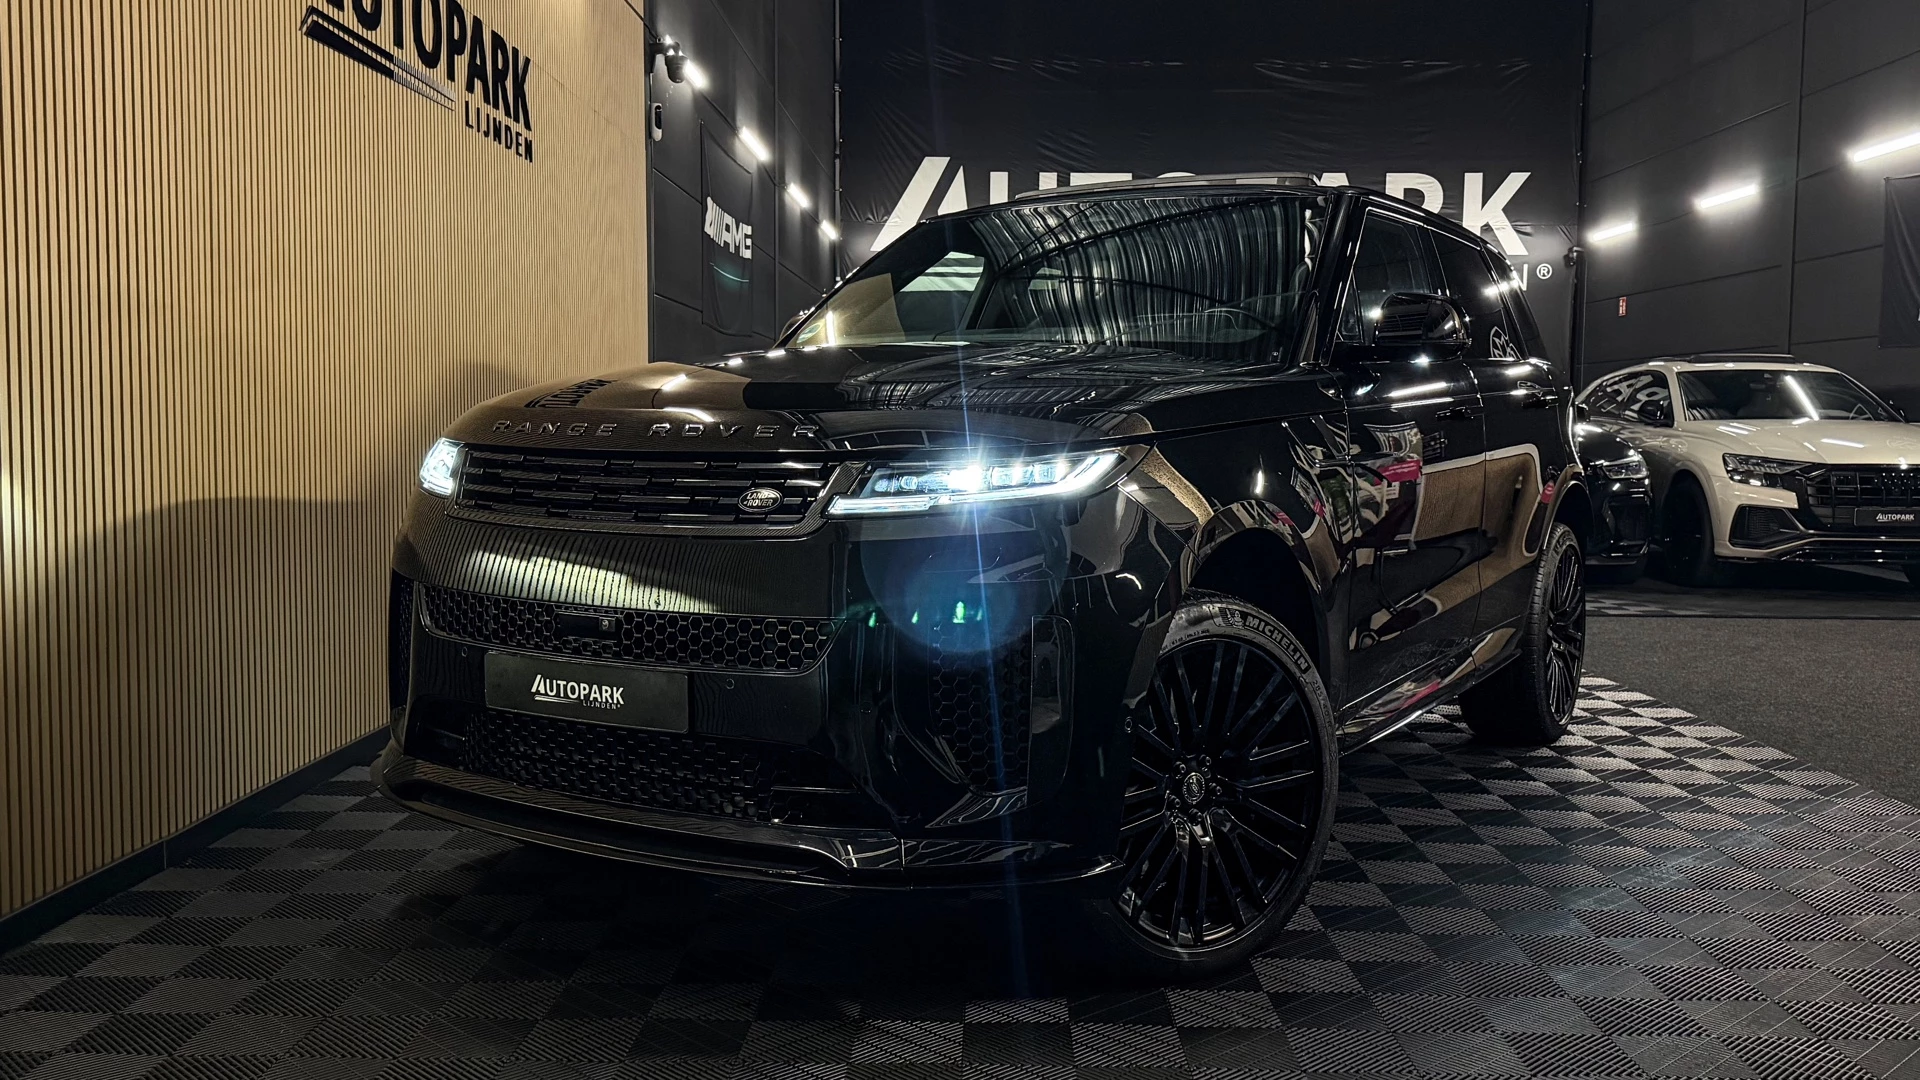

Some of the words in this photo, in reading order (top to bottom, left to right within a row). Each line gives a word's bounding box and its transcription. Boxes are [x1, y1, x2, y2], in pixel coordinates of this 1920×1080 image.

[324, 0, 532, 132] OPARK
[465, 100, 533, 163] LIJNDEN
[492, 420, 617, 437] RANGE
[647, 421, 819, 439] ROVER
[746, 492, 768, 500] LAND
[746, 499, 774, 507] ROVER
[1875, 512, 1915, 522] AUTOPARK
[1245, 614, 1309, 671] MICHELIN
[530, 674, 625, 705] AUTOPARK
